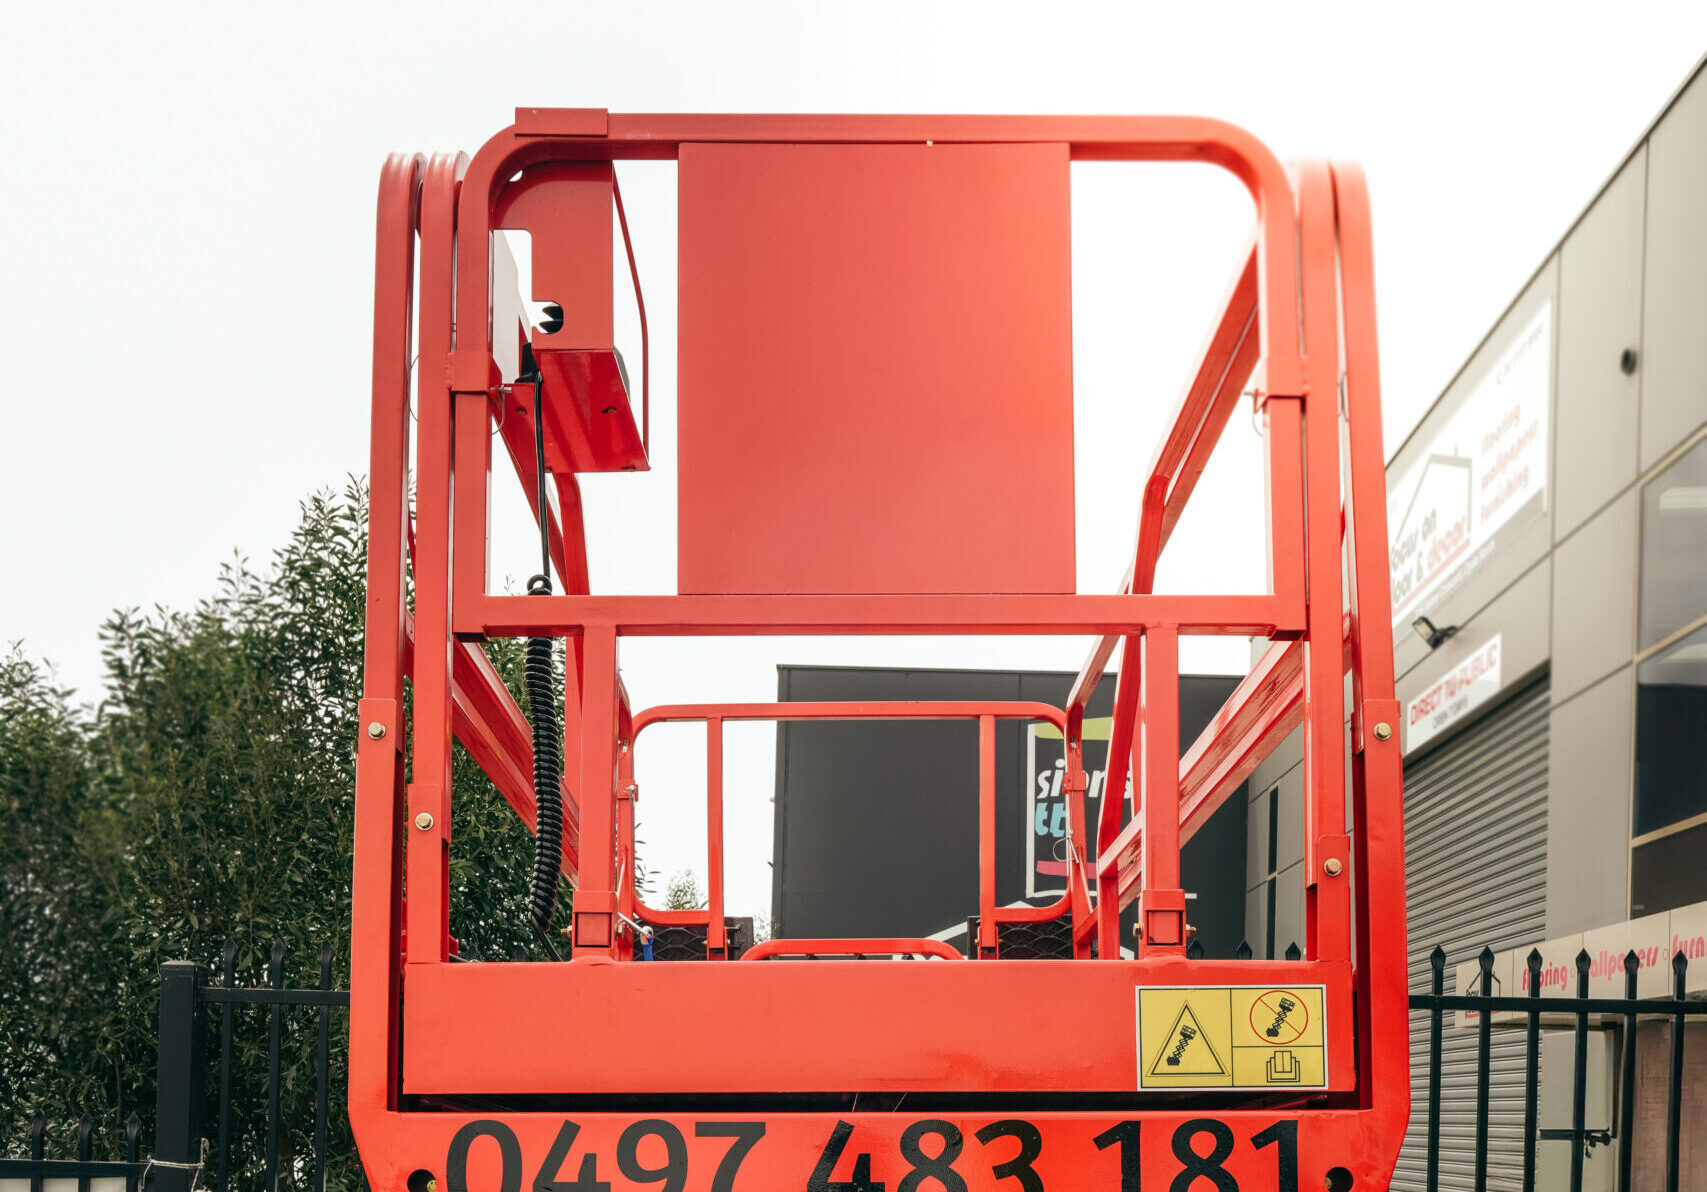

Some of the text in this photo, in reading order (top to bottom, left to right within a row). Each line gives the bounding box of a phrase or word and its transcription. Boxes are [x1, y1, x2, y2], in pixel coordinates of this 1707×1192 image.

[1410, 684, 1443, 727] DIRECT
[1590, 946, 1659, 981] allpaers
[1672, 934, 1707, 961] furn
